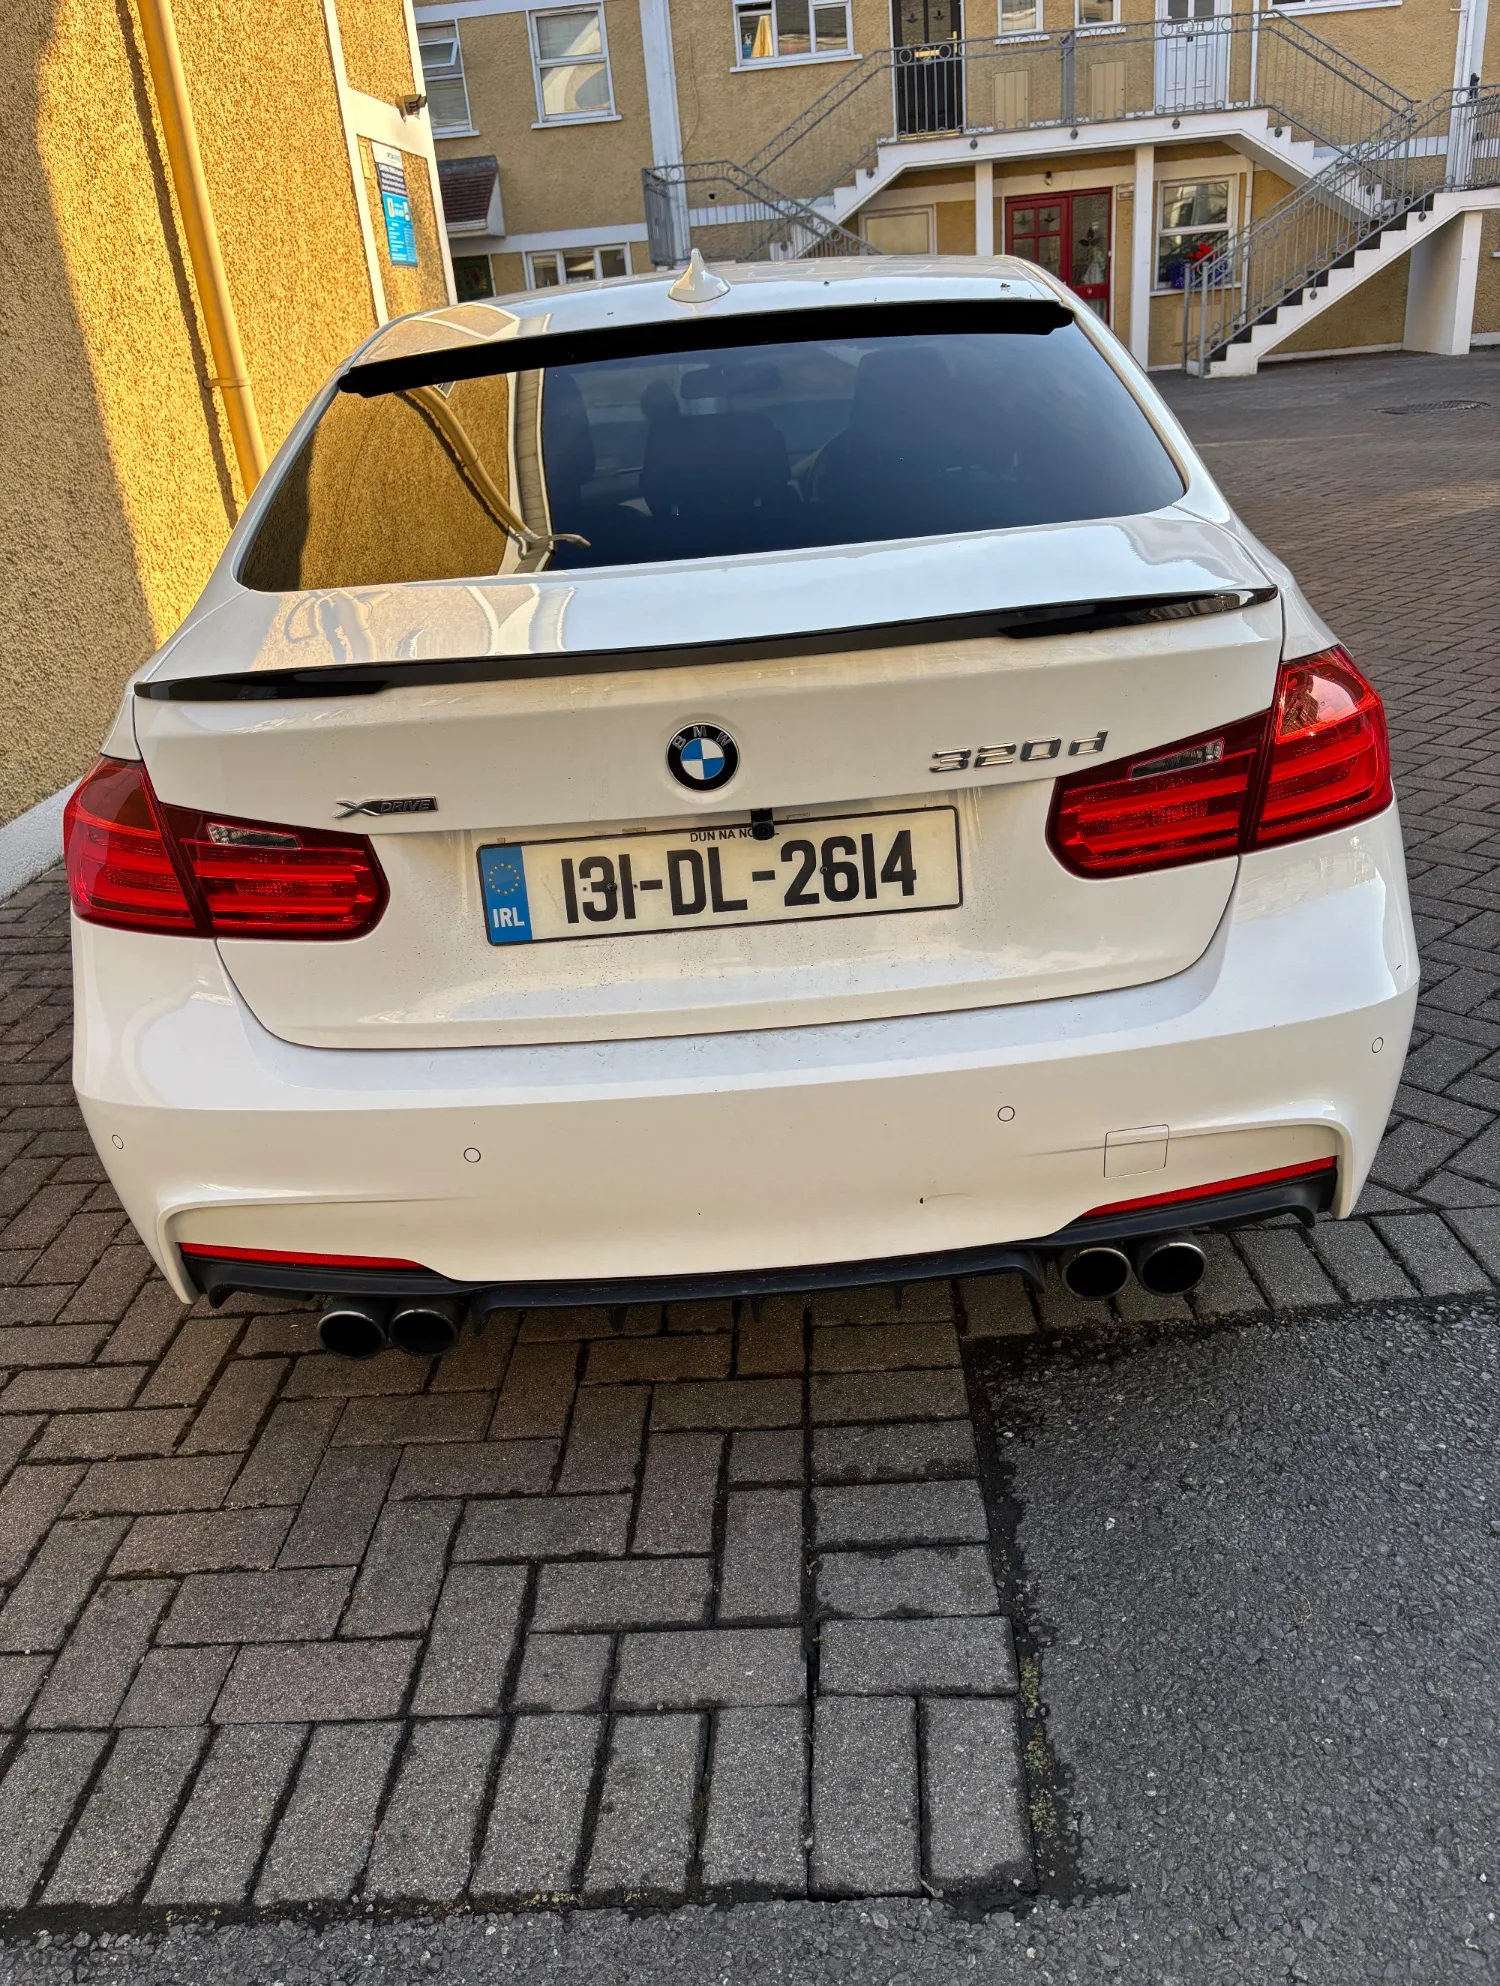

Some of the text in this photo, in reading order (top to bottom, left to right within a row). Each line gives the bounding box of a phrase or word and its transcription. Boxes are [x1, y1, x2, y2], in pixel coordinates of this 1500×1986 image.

[671, 725, 732, 751] BMW
[929, 730, 1109, 773] 320d
[719, 829, 736, 840] NA
[492, 906, 525, 929] IRL
